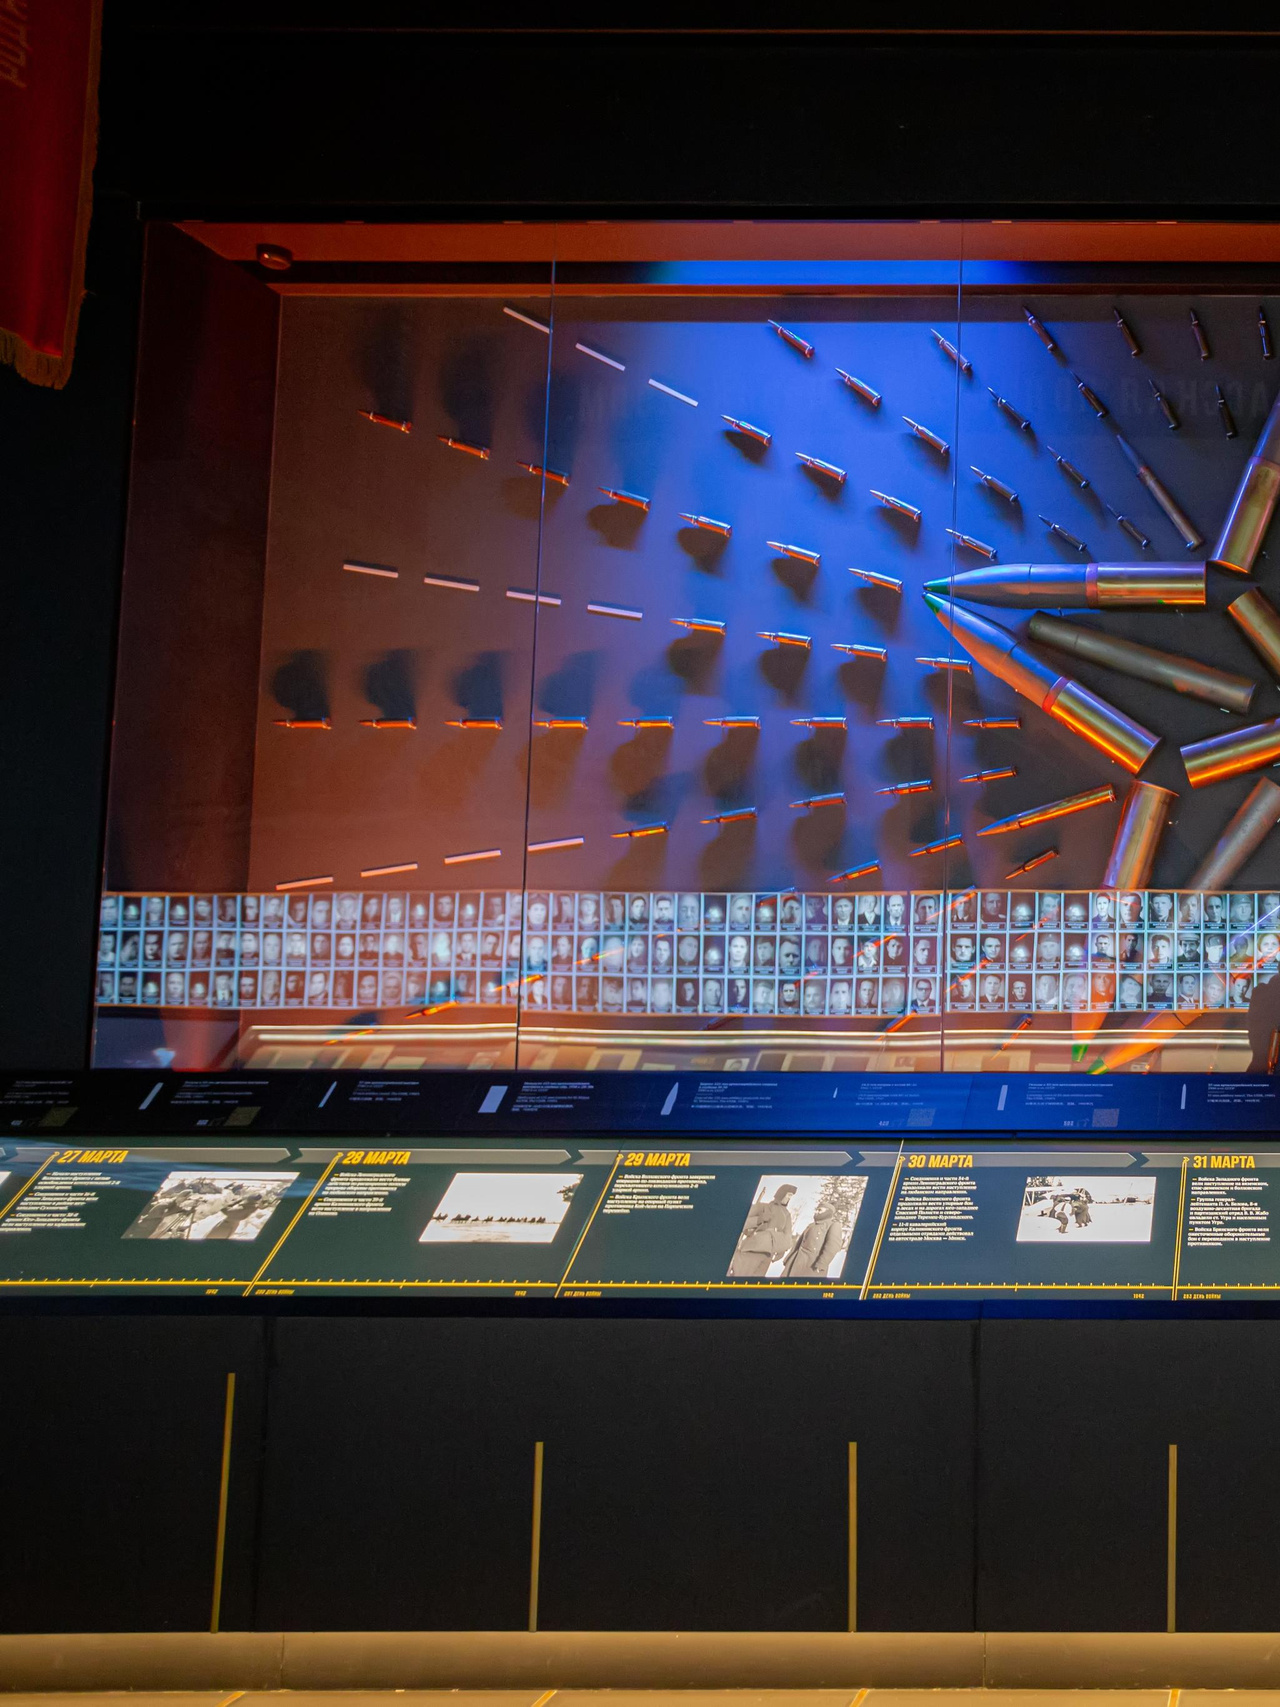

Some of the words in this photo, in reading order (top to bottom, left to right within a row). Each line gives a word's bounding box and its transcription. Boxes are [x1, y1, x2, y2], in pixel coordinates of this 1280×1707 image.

[57, 1150, 82, 1164] 27
[77, 1150, 129, 1164] МАРТА
[342, 1151, 365, 1165] 28
[363, 1151, 411, 1165] МАРТА
[624, 1152, 645, 1167] 29
[645, 1152, 691, 1167] МАРТА
[908, 1154, 926, 1168] 30
[928, 1154, 973, 1168] МАРТА
[1193, 1155, 1208, 1169] 31
[1210, 1155, 1256, 1169] МАРТА
